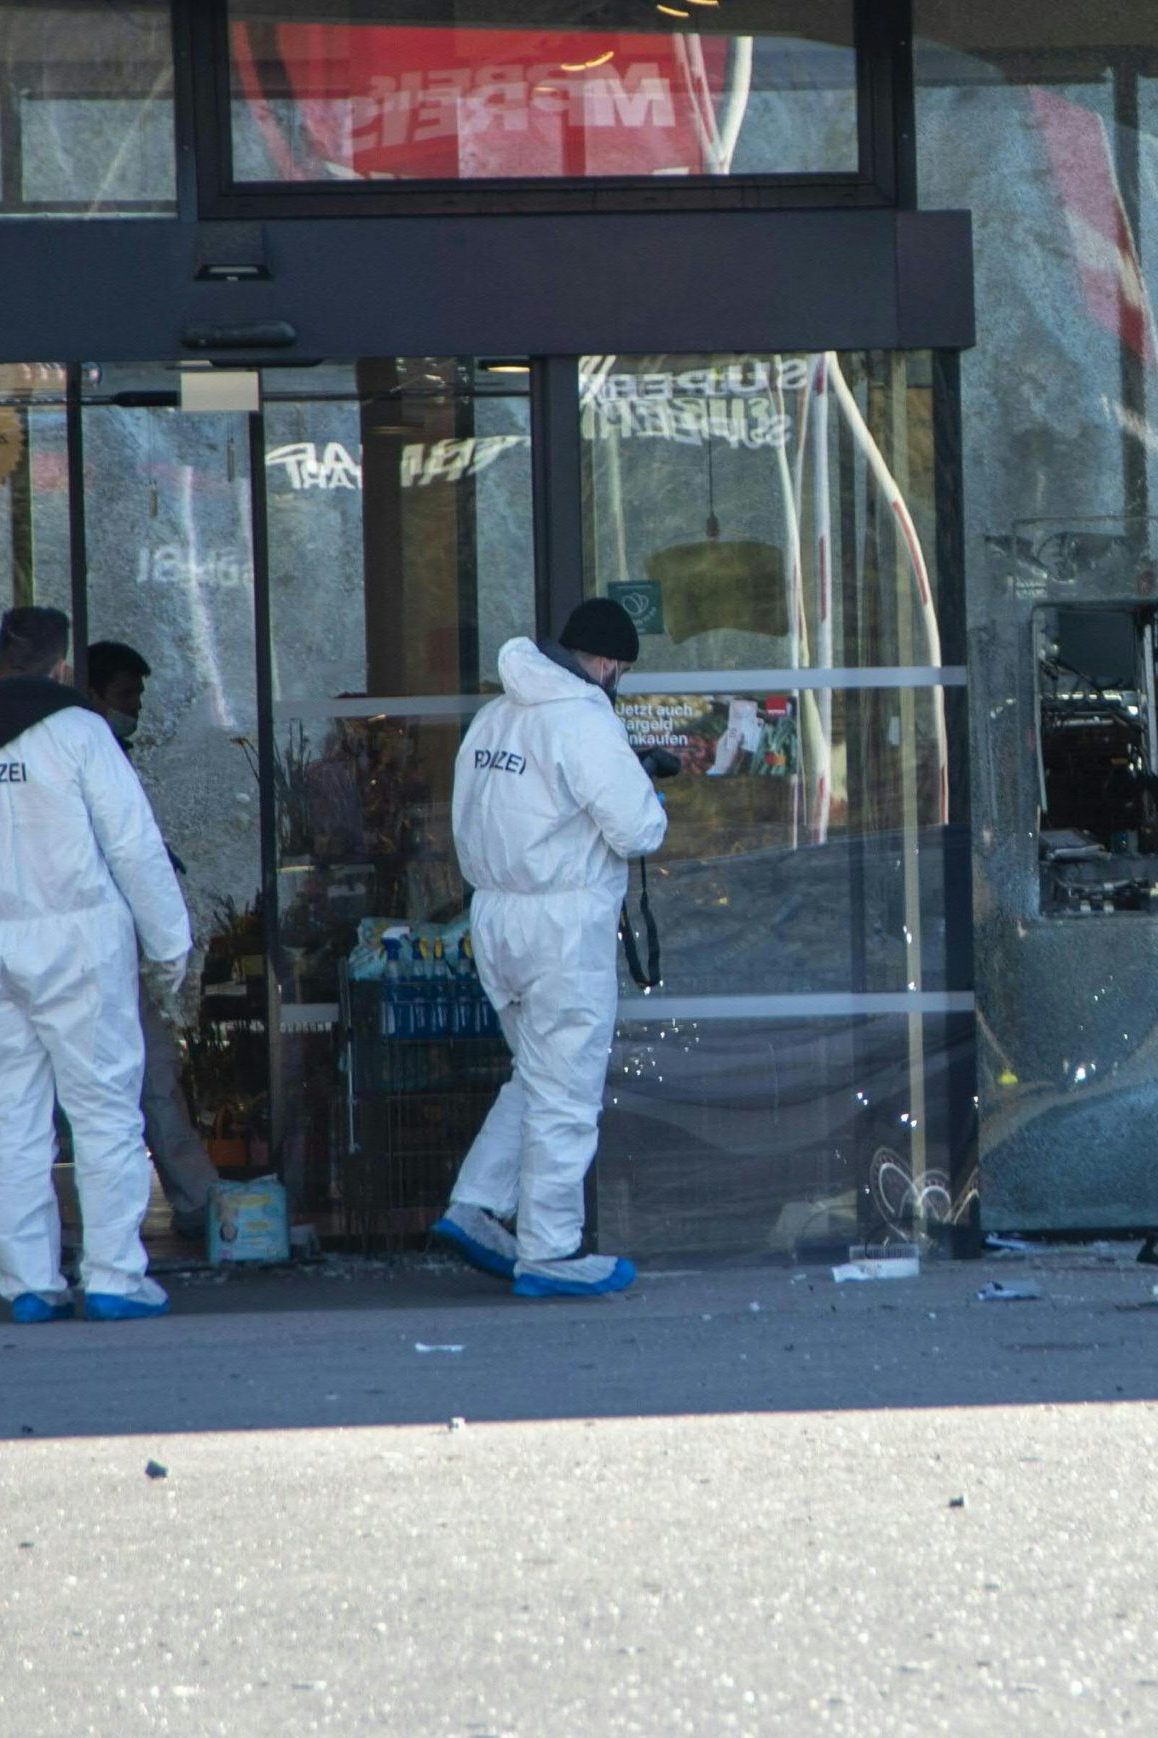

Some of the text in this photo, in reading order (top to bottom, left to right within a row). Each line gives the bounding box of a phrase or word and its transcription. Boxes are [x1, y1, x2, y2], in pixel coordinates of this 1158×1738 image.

[615, 703, 693, 717] Jetzt auch
[629, 732, 688, 746] nkaufen
[474, 749, 528, 775] POIZEI
